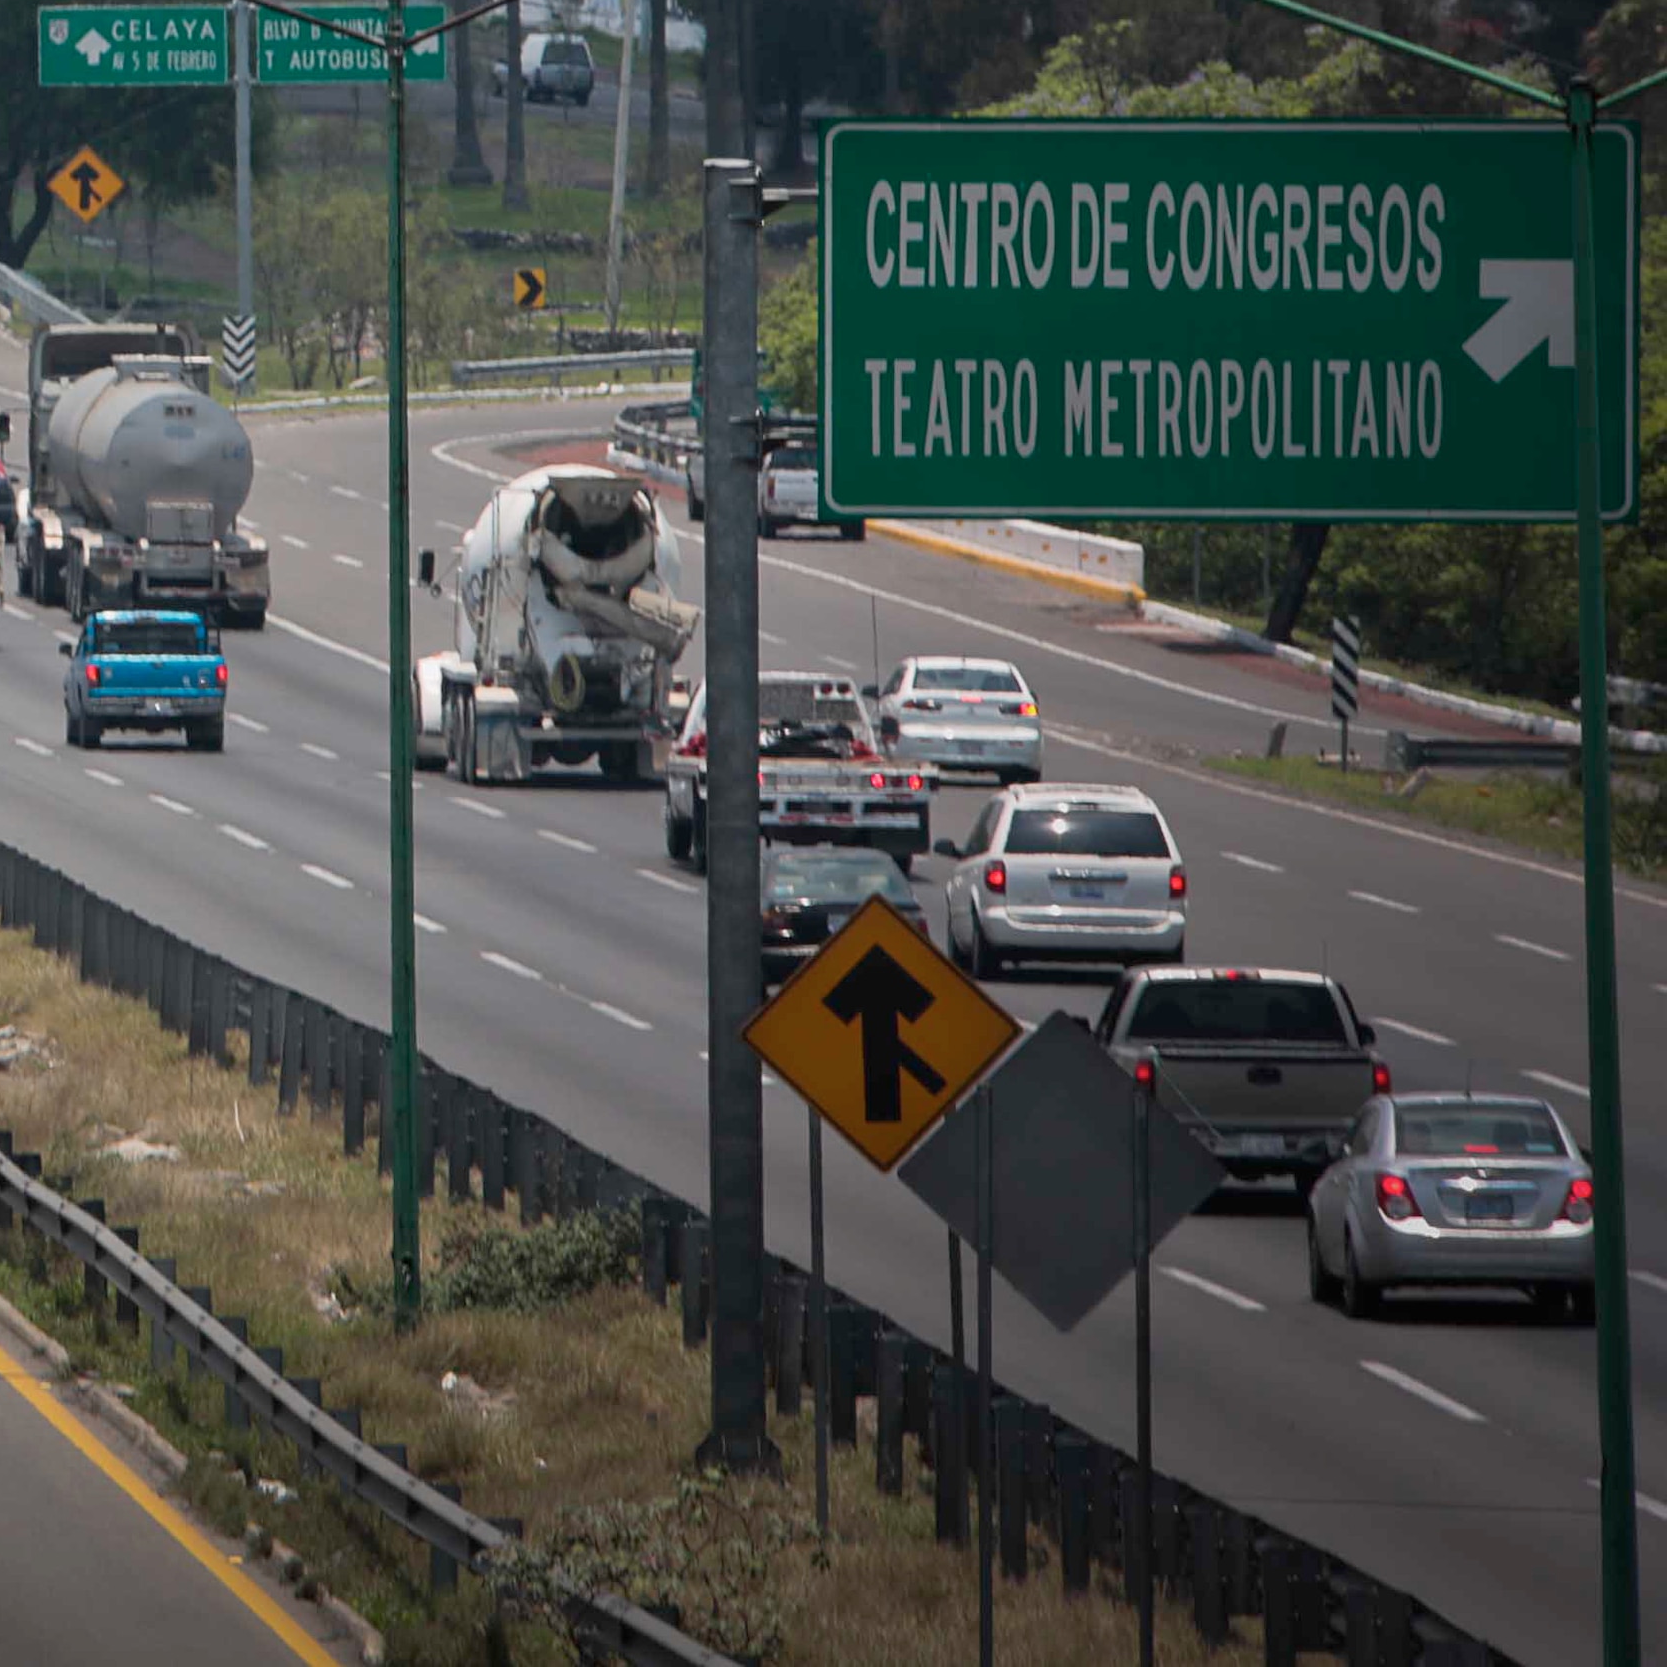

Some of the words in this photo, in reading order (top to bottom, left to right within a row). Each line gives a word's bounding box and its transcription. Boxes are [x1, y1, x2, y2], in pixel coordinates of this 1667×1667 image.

[111, 19, 216, 41] CELAYA
[264, 20, 300, 41] BLVD
[310, 20, 321, 41] B
[333, 19, 406, 41] QUINTA
[112, 51, 124, 70] AV
[132, 51, 140, 70] 5
[146, 51, 159, 70] DE
[167, 49, 218, 70] FEBRERO
[265, 49, 275, 70] T
[289, 48, 407, 70] AUTOBUS
[867, 179, 1055, 291] CENTRO
[1071, 182, 1130, 290] DE
[1146, 181, 1446, 293] CONGRESOS
[865, 358, 1039, 459] TEATRO
[1065, 358, 1444, 460] METROPOLITANO
